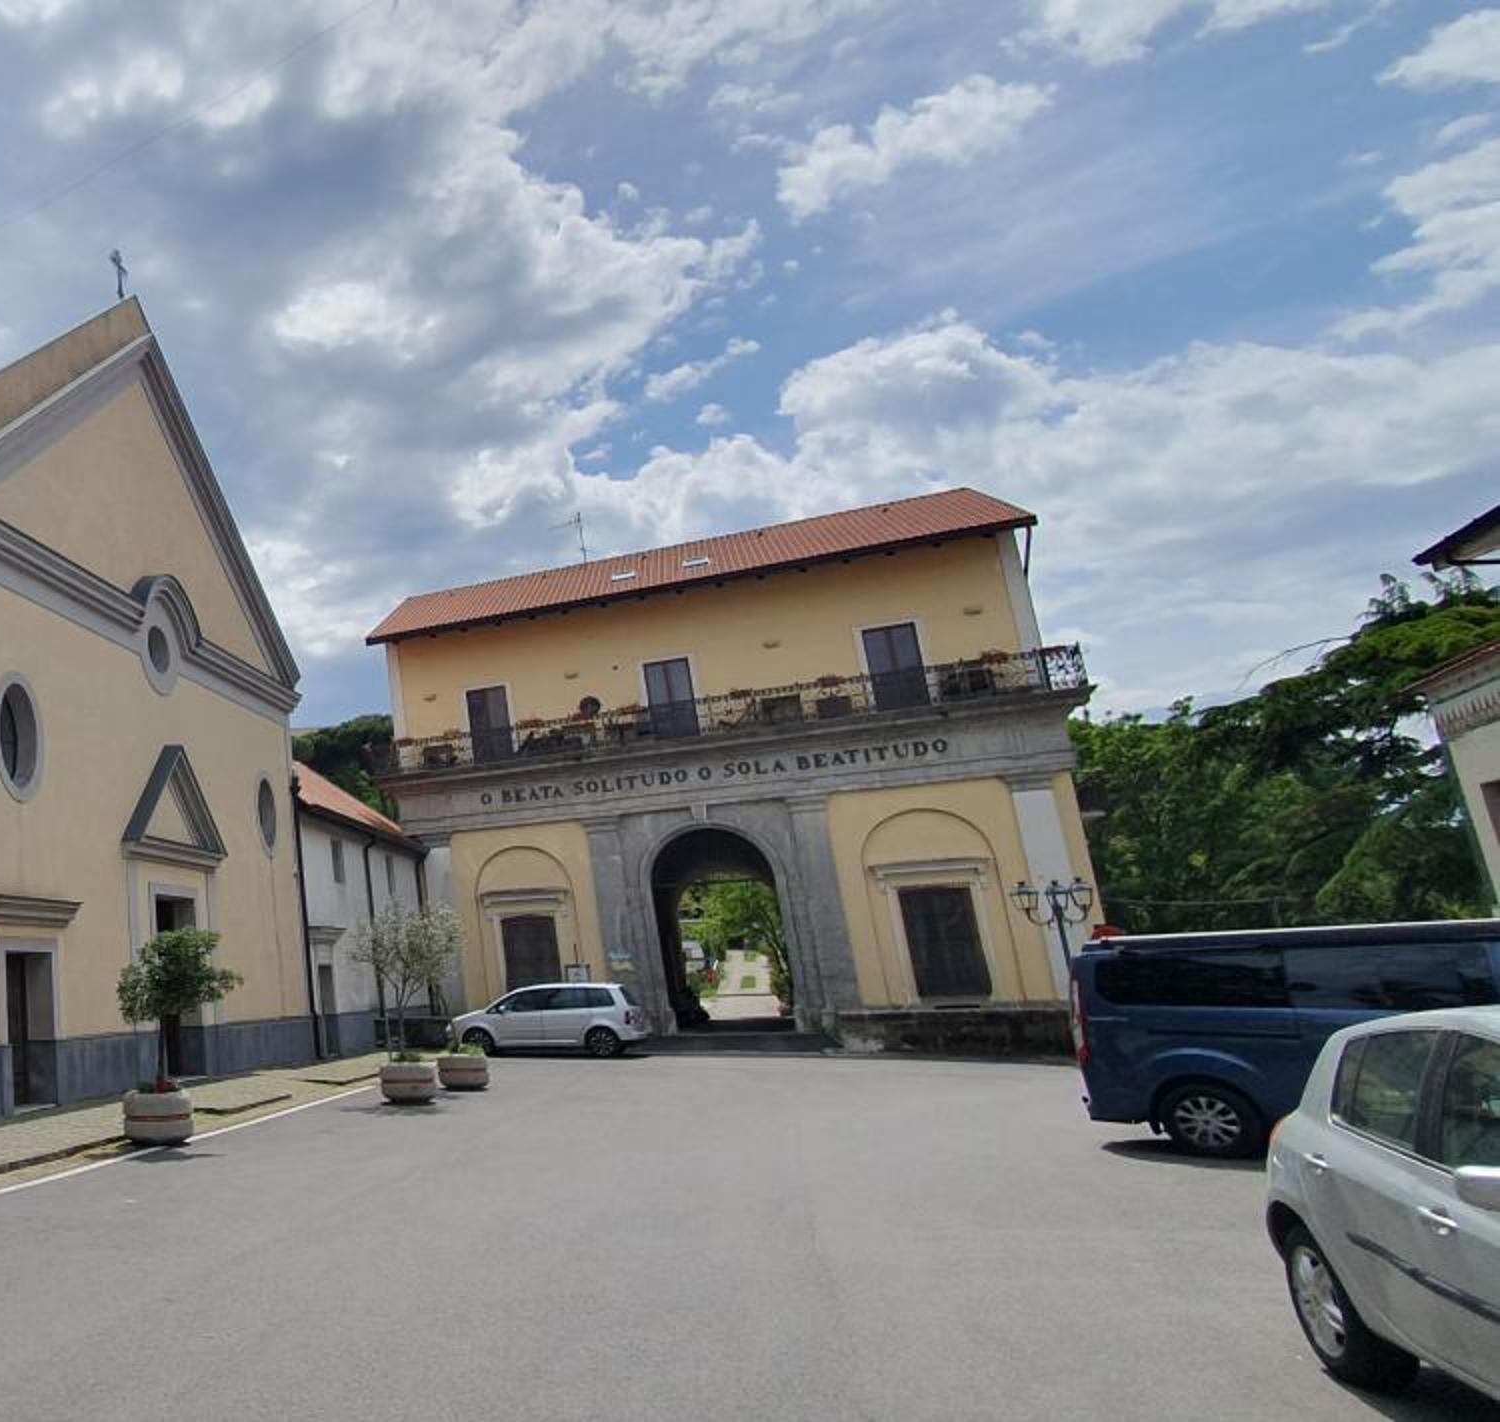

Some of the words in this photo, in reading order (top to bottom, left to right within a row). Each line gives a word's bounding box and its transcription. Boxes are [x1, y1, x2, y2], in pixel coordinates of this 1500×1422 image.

[480, 792, 492, 805] O
[501, 785, 564, 804] BEATA
[573, 769, 688, 797] SOLITUDO
[697, 766, 712, 781] O
[723, 759, 786, 778] SOLA
[795, 738, 948, 771] BEATITUDO
